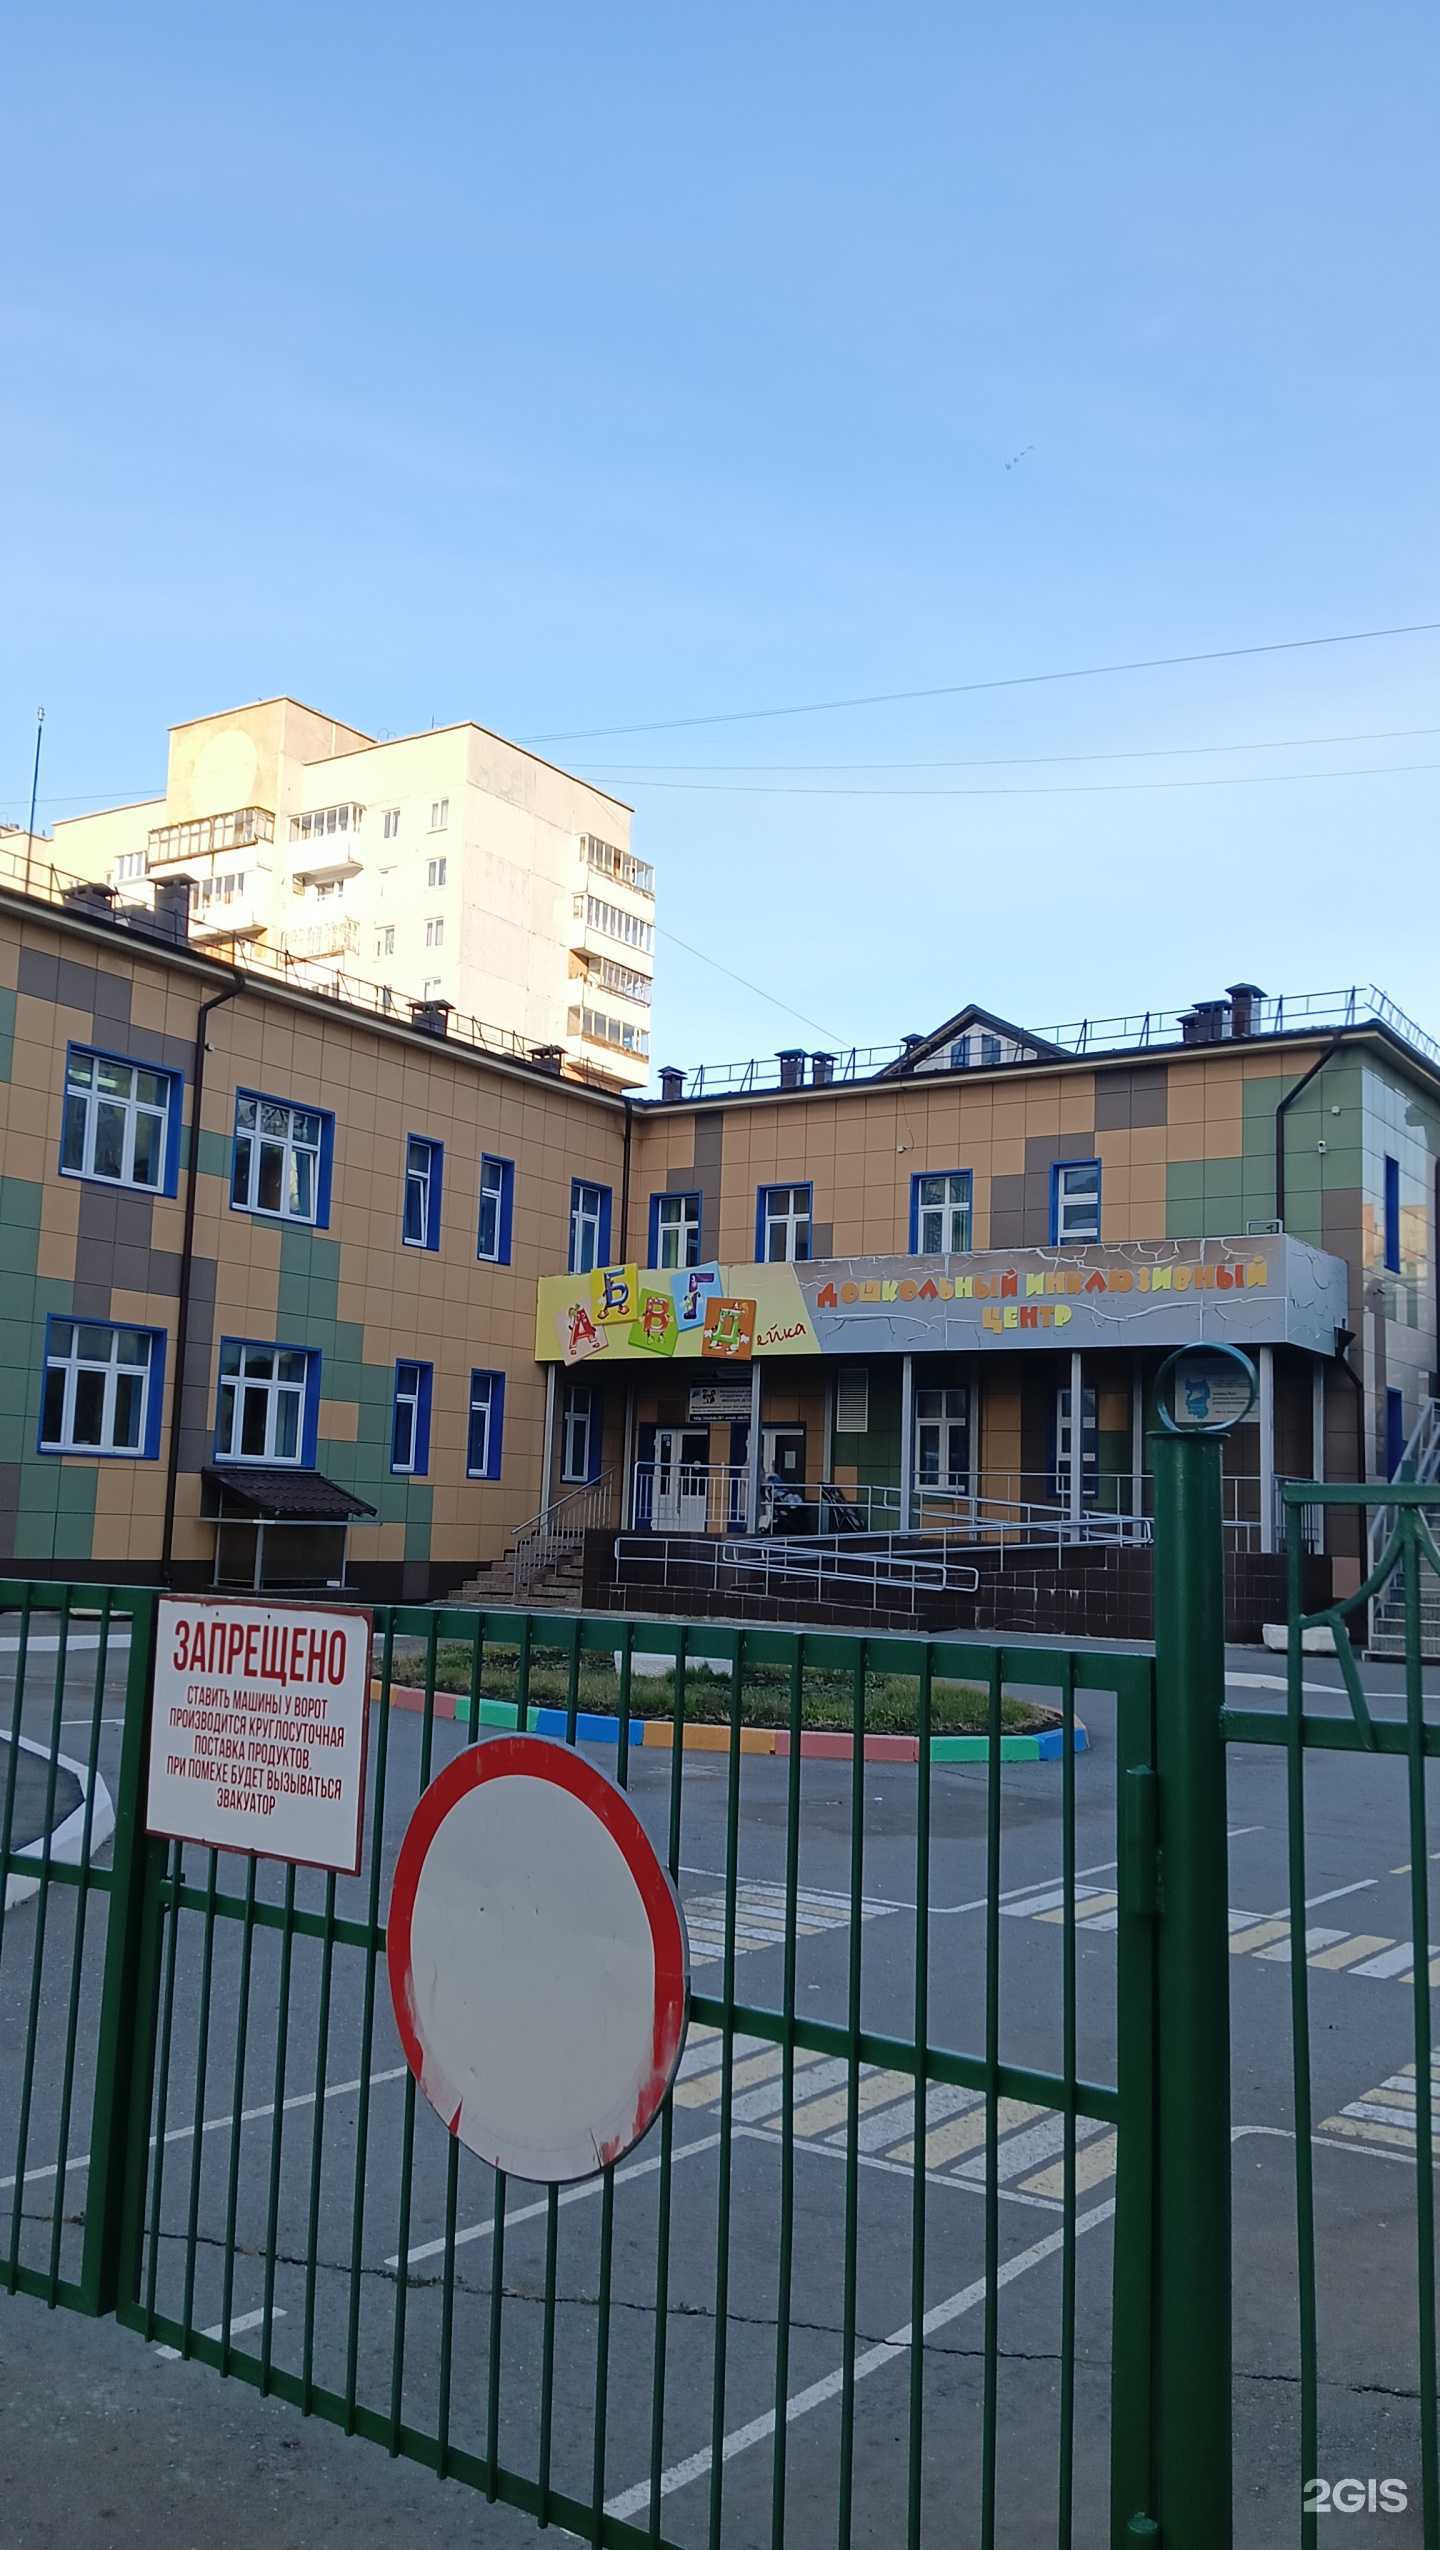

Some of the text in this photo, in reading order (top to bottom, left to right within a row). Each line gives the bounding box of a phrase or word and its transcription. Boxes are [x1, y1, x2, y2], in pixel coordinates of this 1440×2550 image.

[816, 1268, 1018, 1309] ДОШКОЛЬНЫЙ
[981, 1304, 1073, 1335] ЦЕНТР
[173, 1620, 347, 1686] ЗАПРЕЩЕНО
[187, 1685, 328, 1720] СТАВИТЬ МАШИНЫ У ВОРОТ
[169, 1707, 345, 1748] ПРОИЗВОДИТСЯ КРУГЛОСУТОЧНАЯ
[194, 1735, 312, 1770] ПОСТАВКА ПРОДУКТОВ.
[167, 1755, 342, 1800] ПРИ ПОМЕХЕ БУДЕТ ВЫЗЫВАТЬСЯ
[217, 1787, 276, 1815] ЭВАКУАТОР
